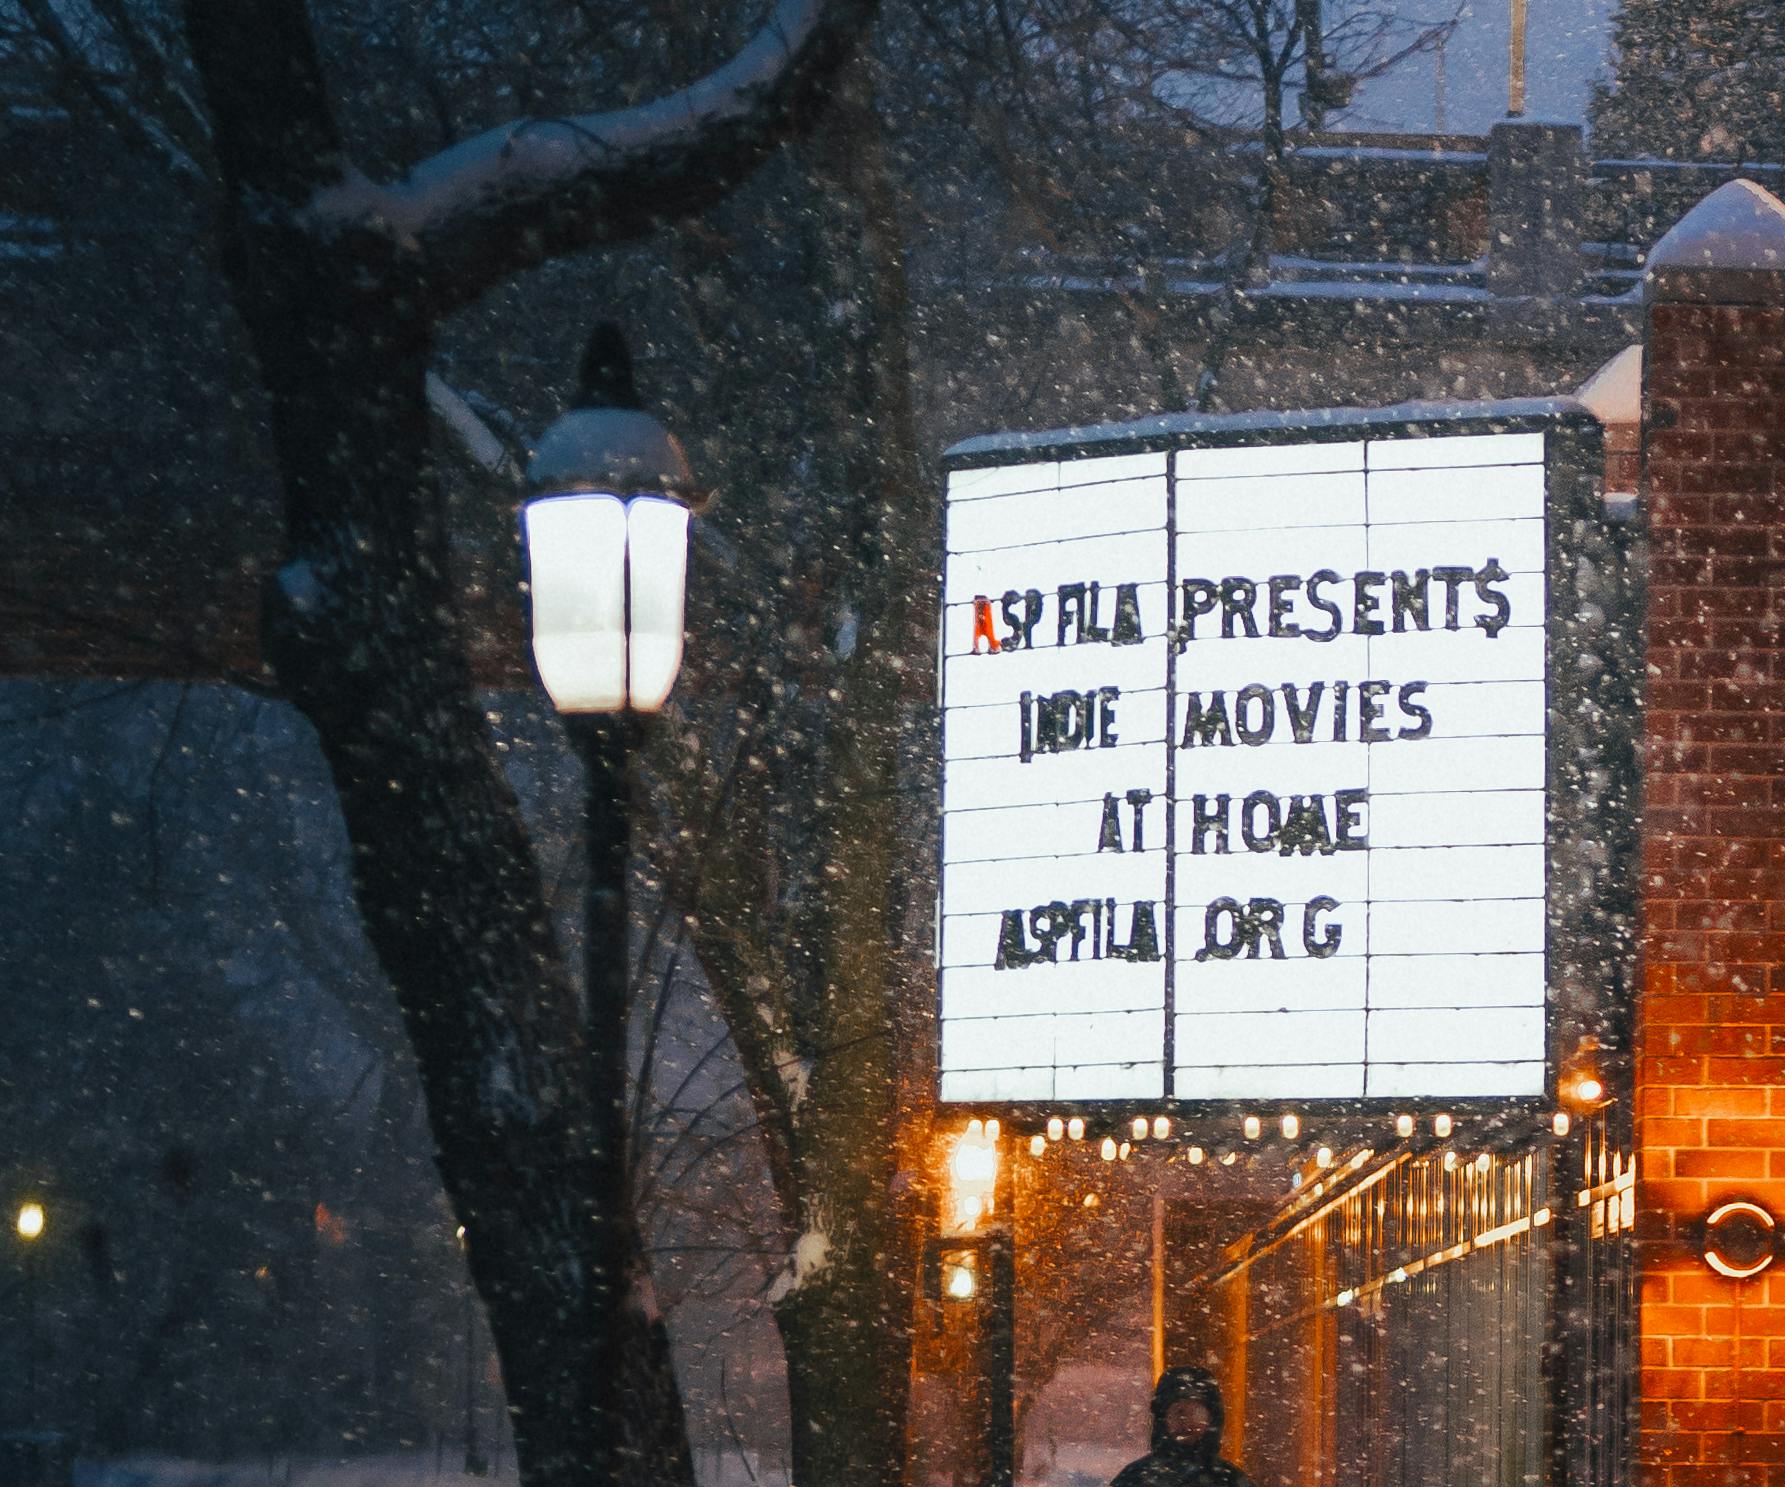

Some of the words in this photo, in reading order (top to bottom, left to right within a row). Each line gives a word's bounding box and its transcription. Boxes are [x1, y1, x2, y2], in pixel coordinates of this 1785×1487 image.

[1020, 685, 1120, 763] INDIE
[1179, 679, 1433, 750] MOVIES
[1098, 787, 1152, 853] AT
[1192, 788, 1368, 857] HOME
